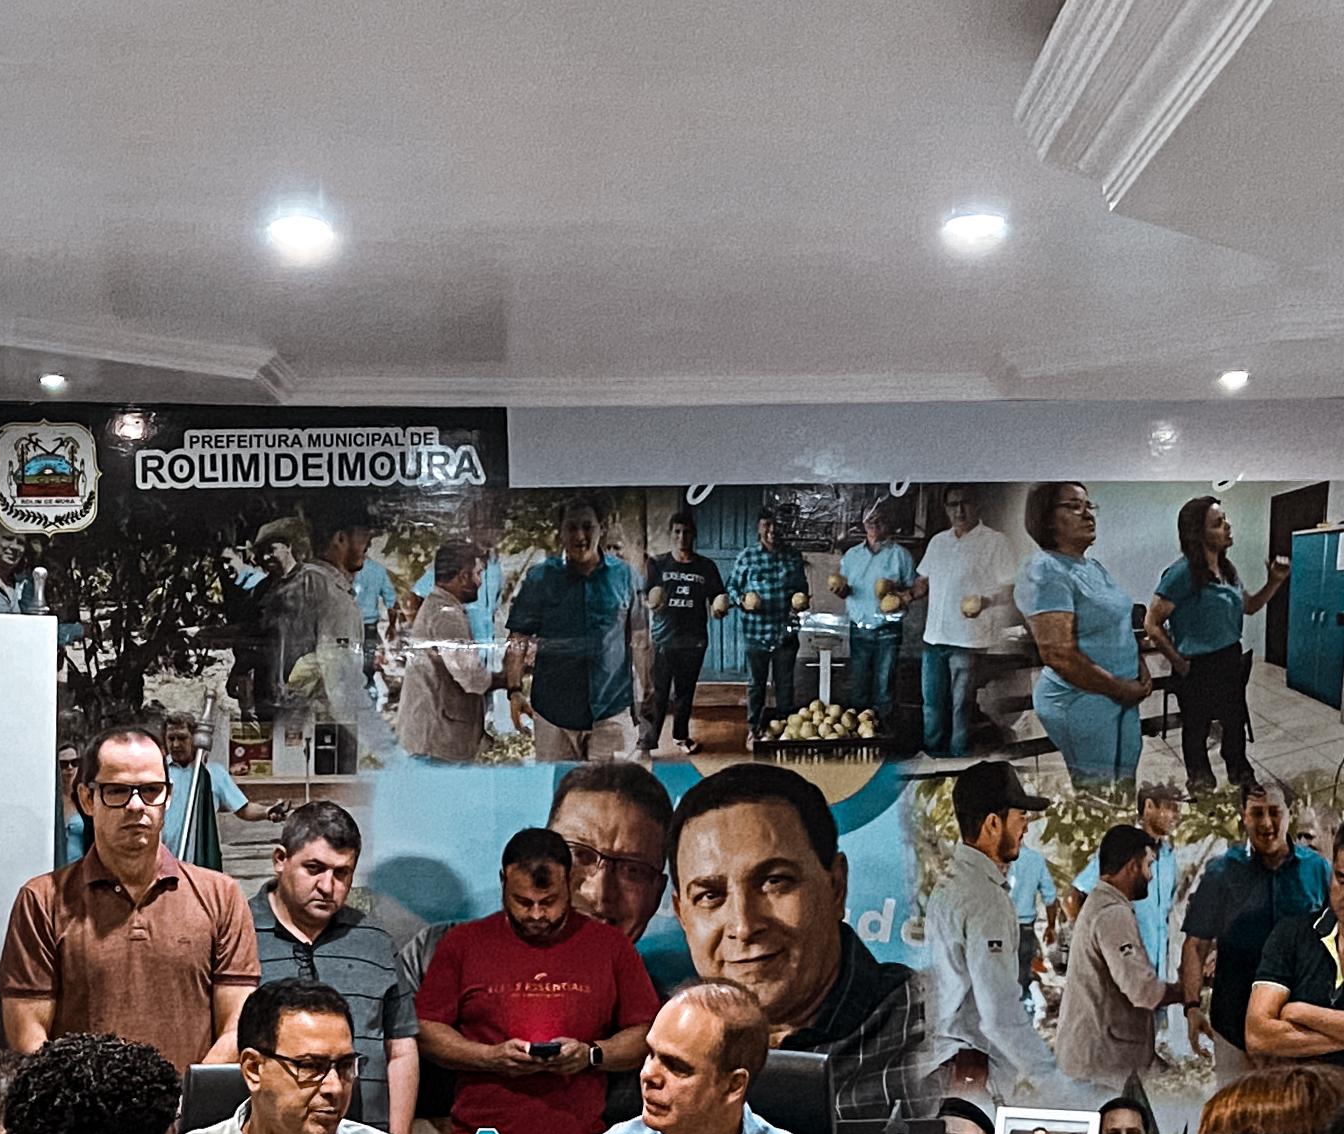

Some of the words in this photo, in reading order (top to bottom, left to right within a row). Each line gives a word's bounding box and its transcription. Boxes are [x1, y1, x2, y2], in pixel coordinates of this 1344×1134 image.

[189, 433, 303, 449] PREFEITURA
[307, 433, 405, 448] MUNICIPAL
[410, 432, 434, 446] DE
[141, 453, 258, 484] ROLIM
[274, 452, 324, 482] DE
[338, 450, 481, 482] MOURA
